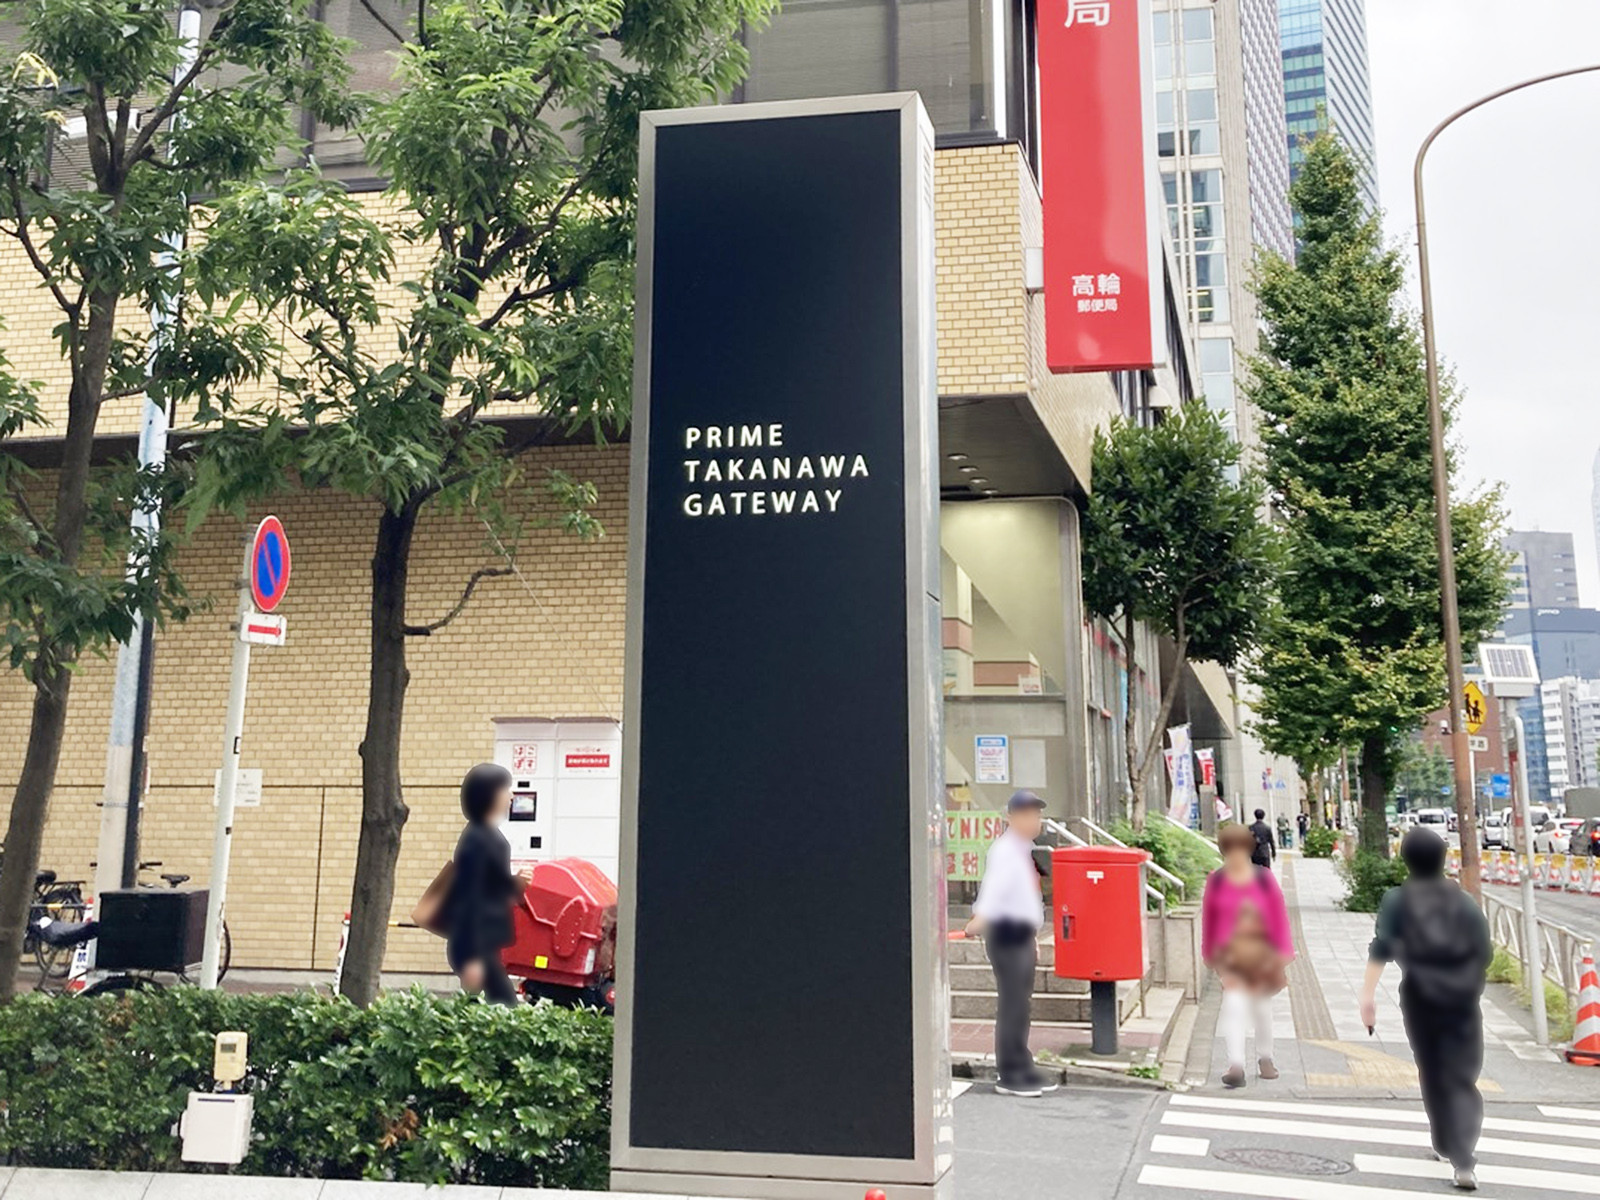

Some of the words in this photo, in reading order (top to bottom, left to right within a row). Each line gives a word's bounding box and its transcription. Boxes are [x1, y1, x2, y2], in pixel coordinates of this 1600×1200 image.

[1071, 273, 1121, 297] 高輪
[1077, 298, 1118, 313] 郵便局
[685, 423, 784, 450] PRIME
[683, 454, 870, 483] TAKANAWA
[683, 489, 842, 517] GATEWAY
